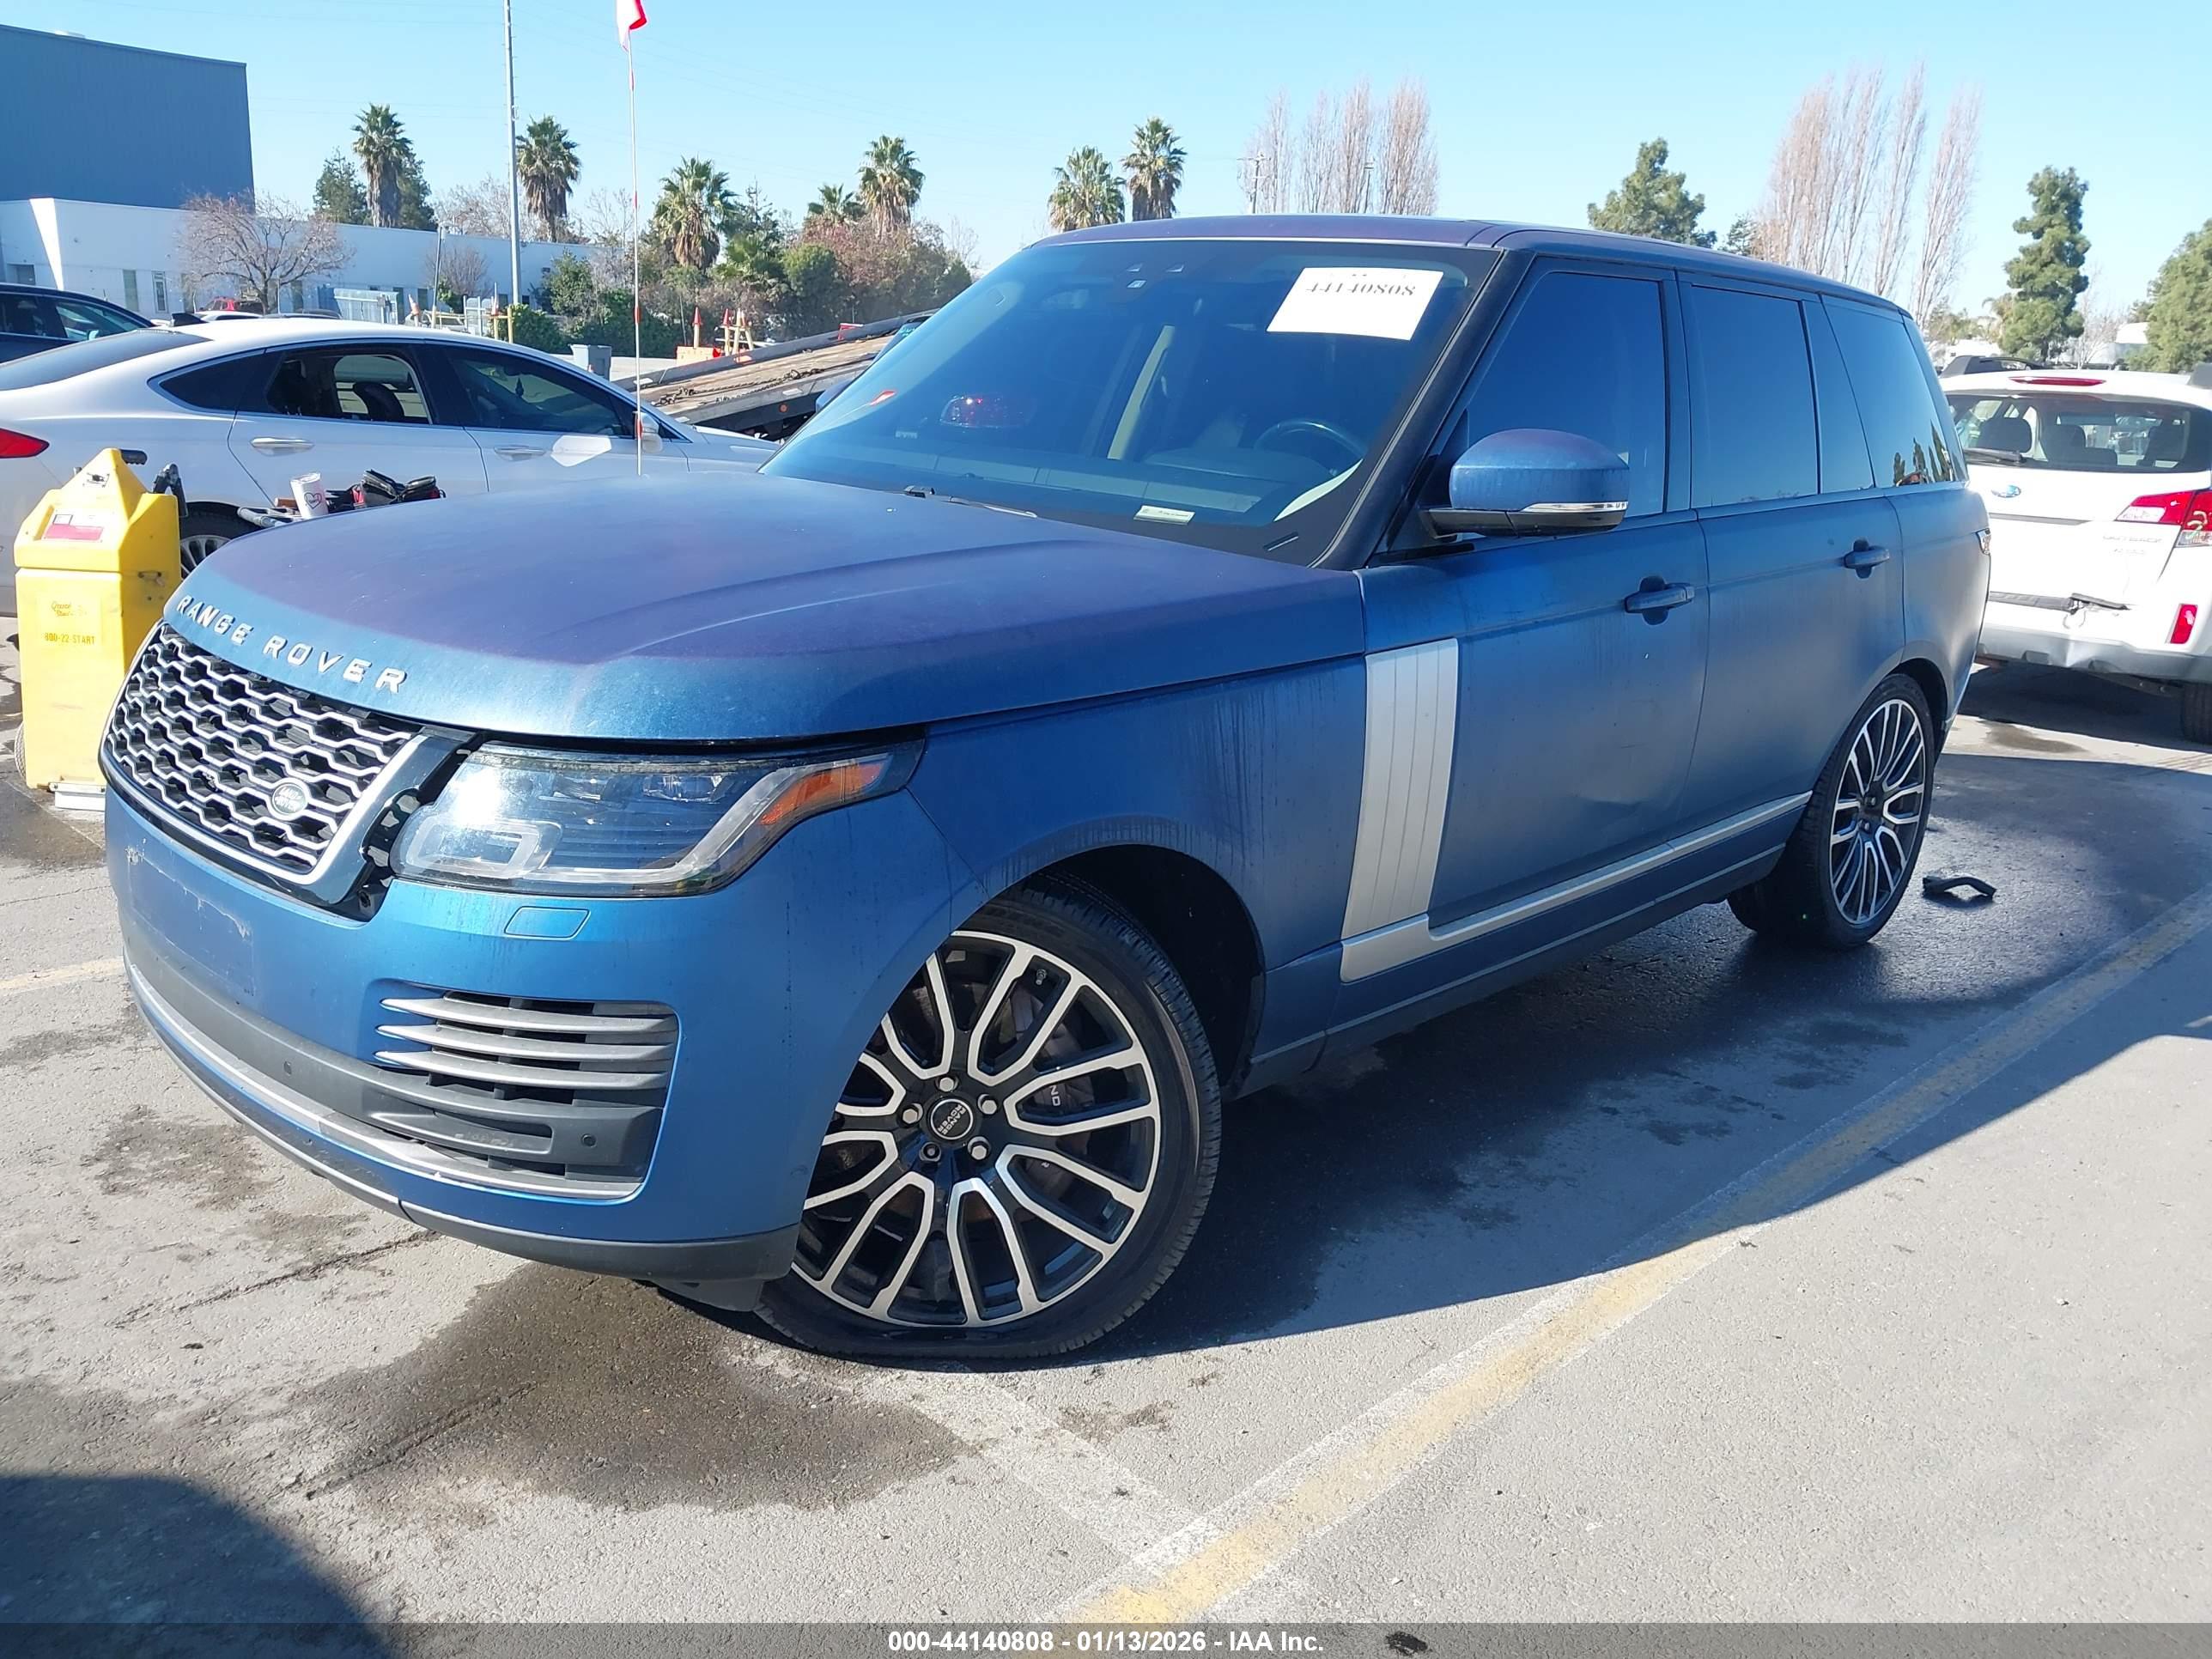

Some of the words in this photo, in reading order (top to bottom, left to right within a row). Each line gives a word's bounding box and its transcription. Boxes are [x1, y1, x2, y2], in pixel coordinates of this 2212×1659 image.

[175, 594, 254, 646] RANGE
[262, 634, 408, 694] ROVER
[937, 1103, 963, 1132] ROVER
[941, 1107, 967, 1135] RANGE
